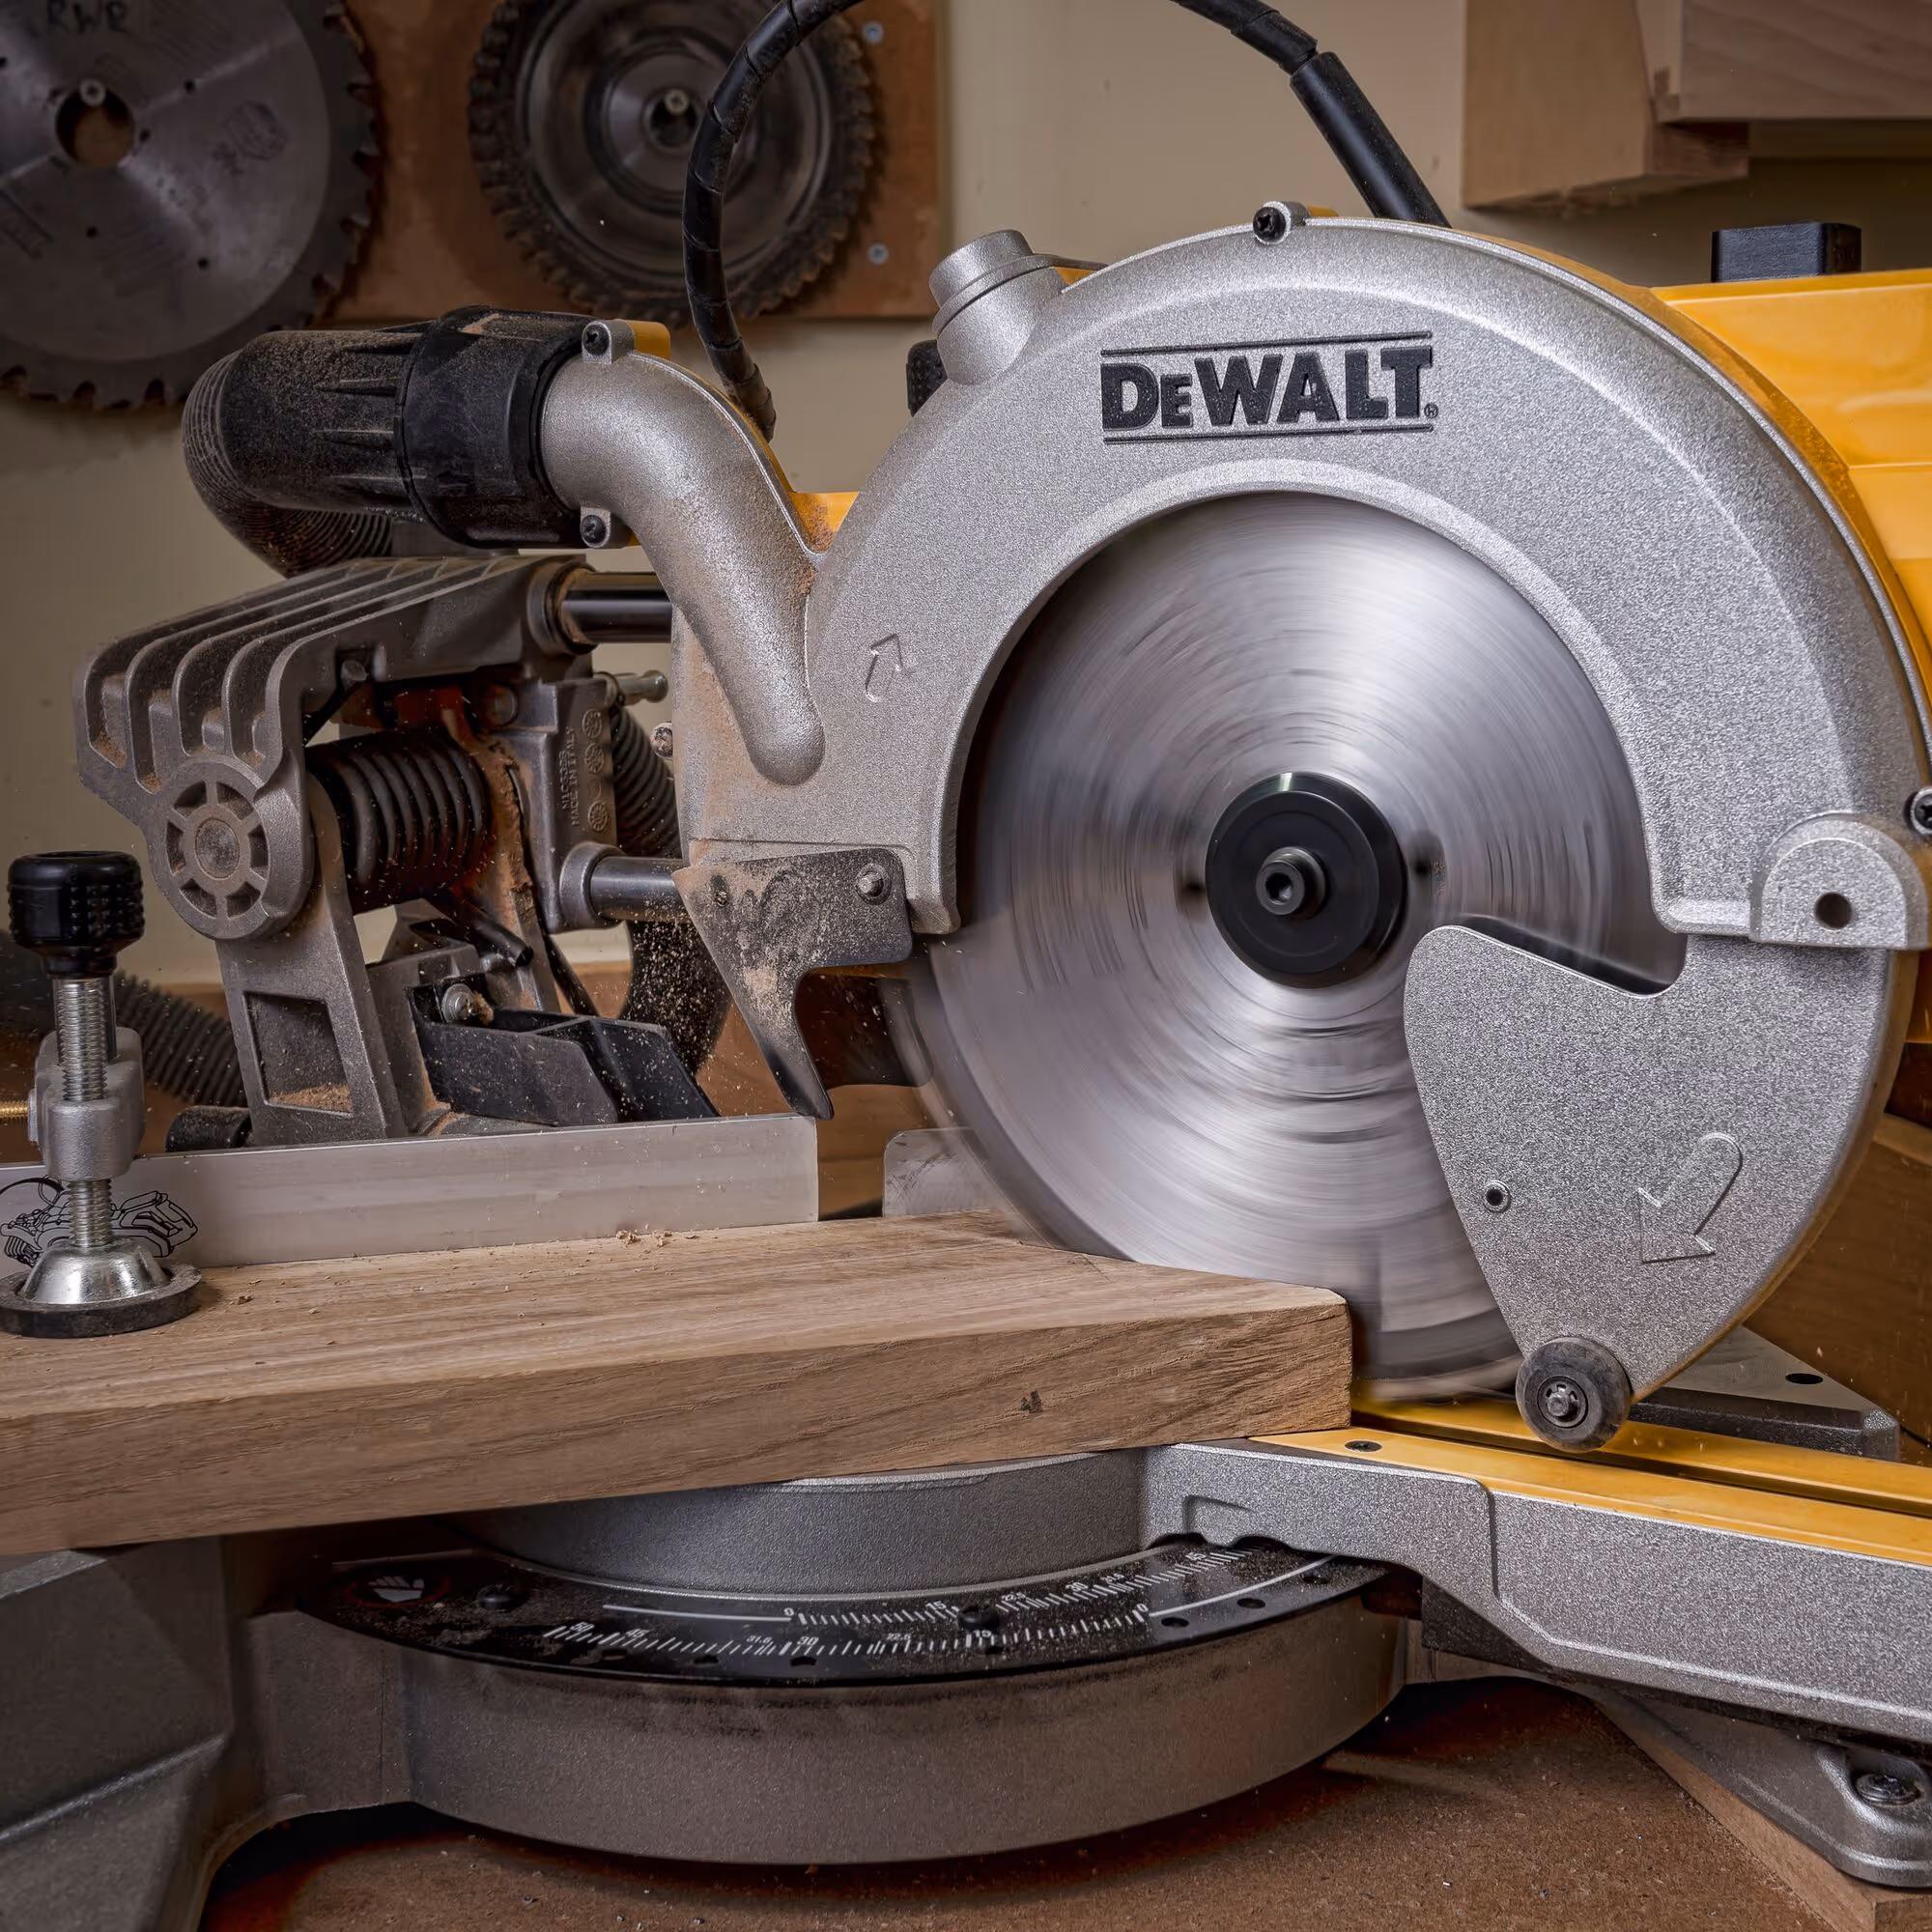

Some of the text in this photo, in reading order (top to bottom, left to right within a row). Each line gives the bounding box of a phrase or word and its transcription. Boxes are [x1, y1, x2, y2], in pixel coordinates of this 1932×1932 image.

[565, 725, 580, 828] MADE IN ITALY
[783, 1607, 794, 1616] 0
[1136, 1603, 1149, 1612] 0
[797, 1635, 819, 1646] 30
